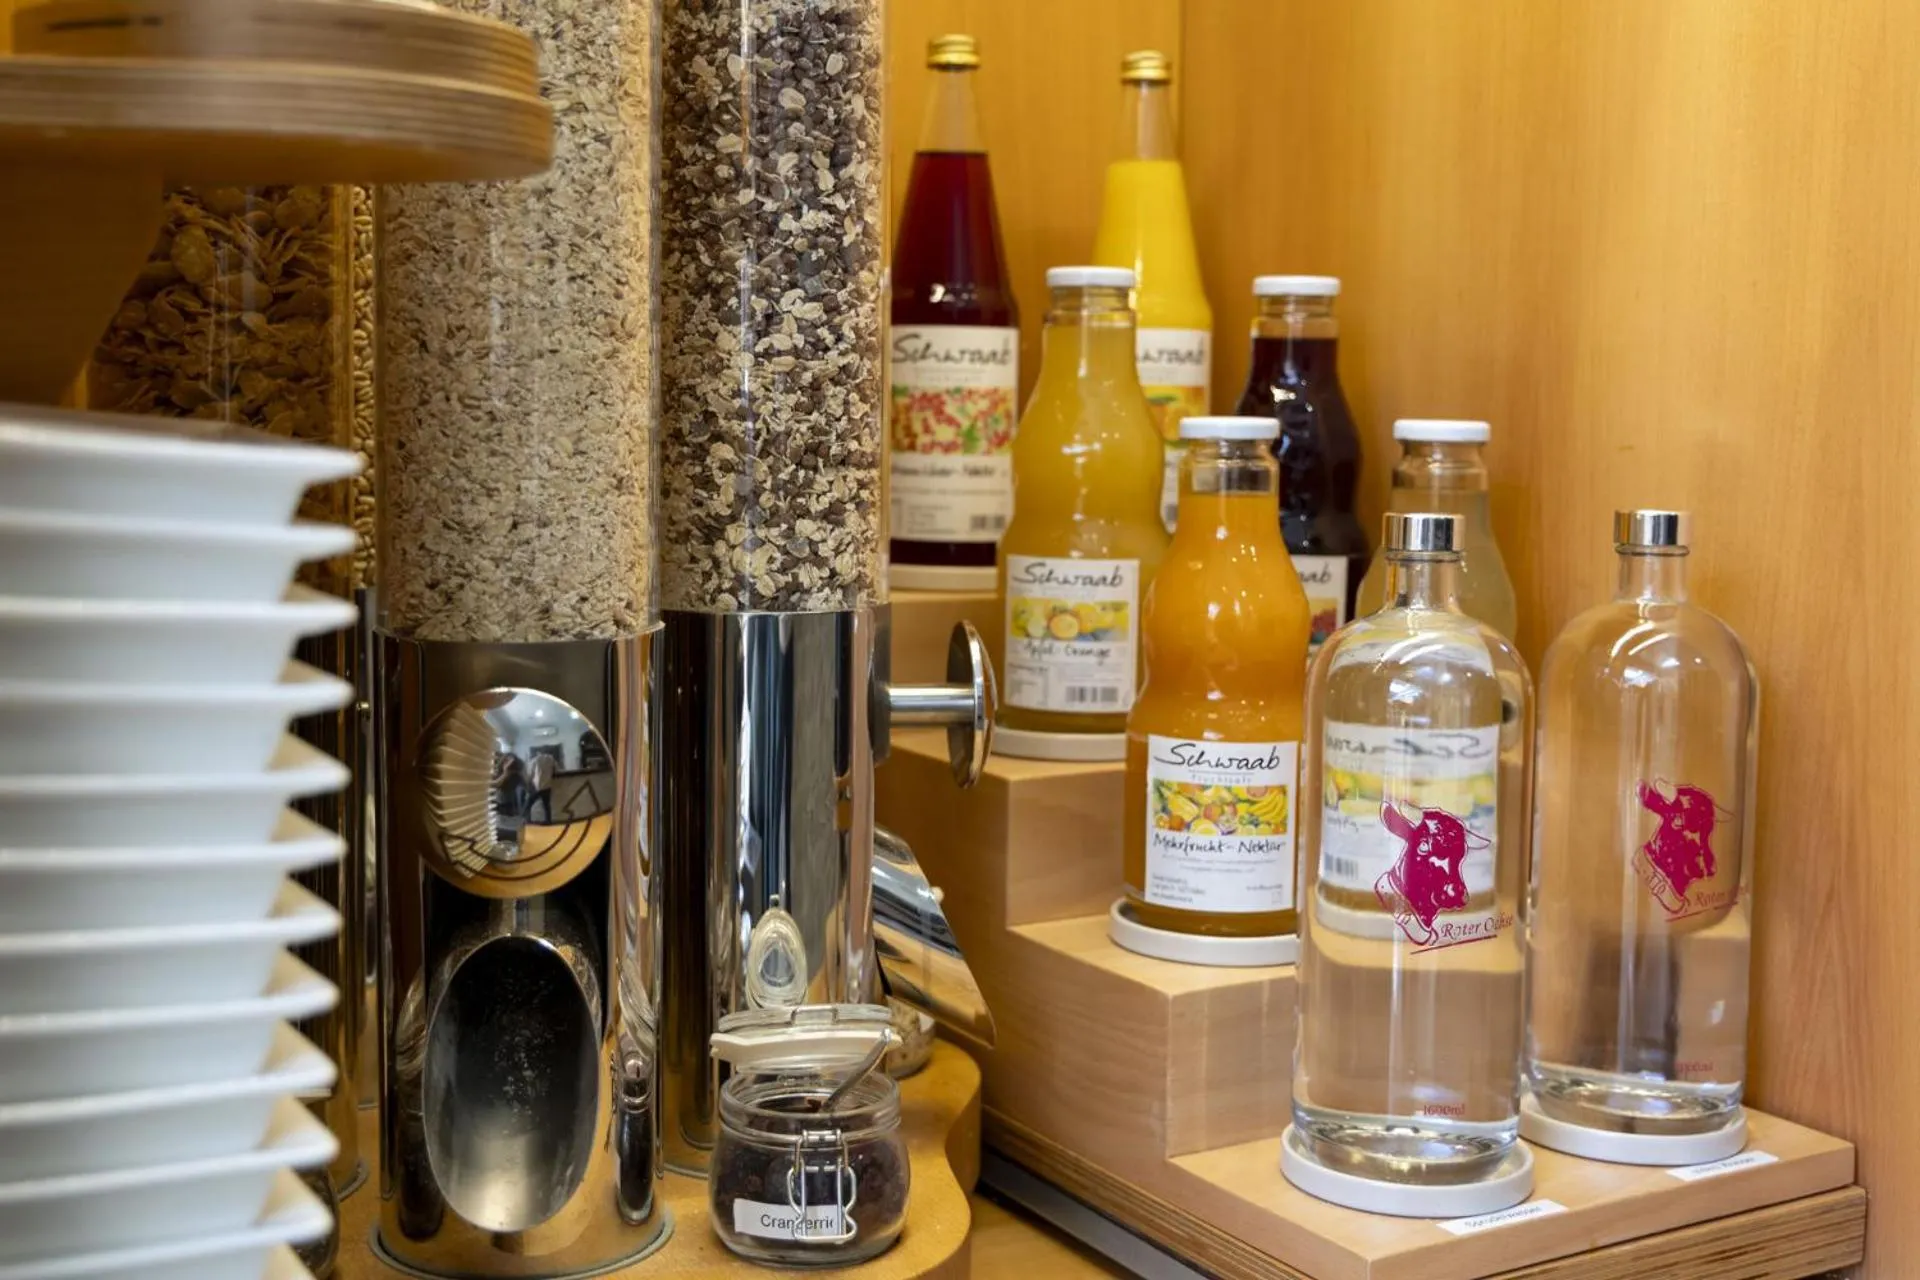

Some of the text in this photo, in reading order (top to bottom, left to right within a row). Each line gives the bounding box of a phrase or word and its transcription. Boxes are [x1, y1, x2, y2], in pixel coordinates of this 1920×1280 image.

[892, 333, 1010, 365] Schwaab
[1012, 562, 1124, 588] Schwaab
[1153, 743, 1280, 770] Schwaab
[1441, 922, 1481, 940] Roter
